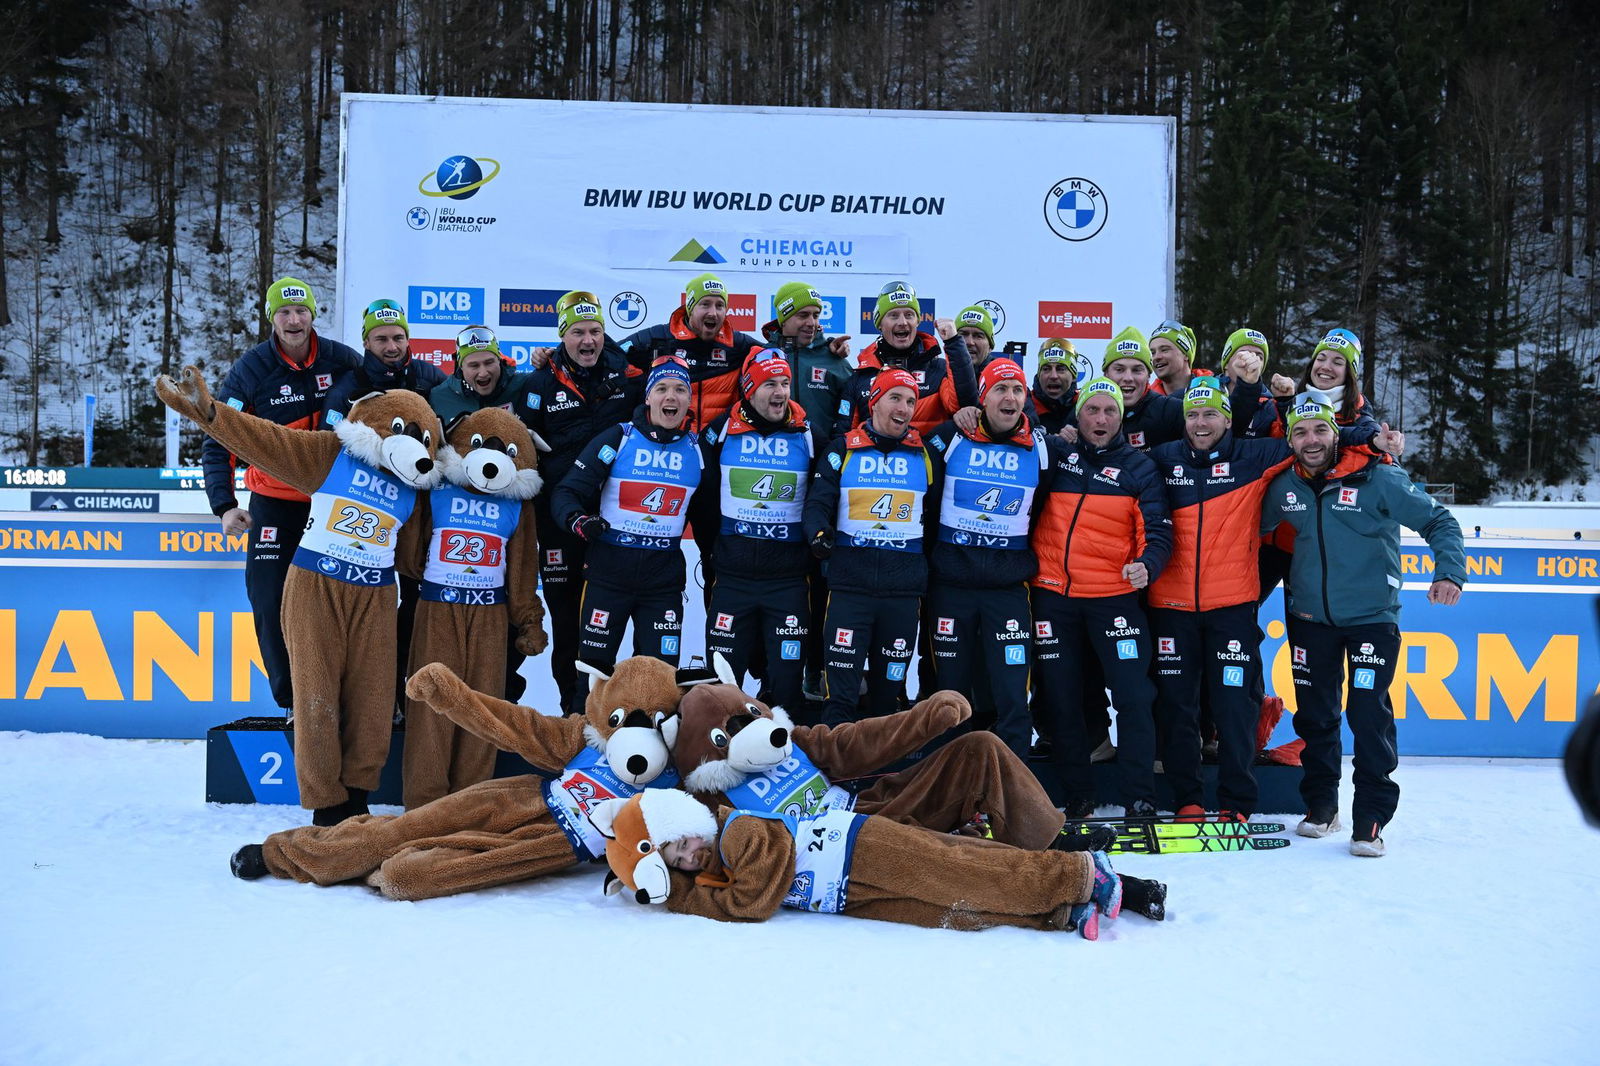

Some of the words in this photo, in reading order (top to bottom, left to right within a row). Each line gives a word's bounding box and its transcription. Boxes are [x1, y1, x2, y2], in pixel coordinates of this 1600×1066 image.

[1053, 181, 1099, 198] BMW
[584, 188, 642, 208] BMW
[647, 190, 686, 208] IBU
[691, 192, 772, 211] WORLD
[778, 193, 826, 212] CUP
[830, 195, 945, 215] BIATHLON
[440, 208, 456, 216] IBU
[438, 216, 476, 224] WORLD
[476, 217, 497, 225] CUP
[437, 224, 482, 232] BIATHLON
[740, 238, 854, 256] CHIEMGAU
[740, 258, 854, 268] RUHPOLDING
[283, 288, 304, 298] claro
[890, 292, 910, 300] claro
[421, 291, 472, 312] DKB
[501, 302, 558, 313] HÖRMA
[376, 309, 398, 318] claro
[576, 304, 596, 314] claro
[962, 312, 982, 321] claro
[1041, 312, 1110, 328] VIESSMANN
[1118, 342, 1138, 351] claro
[1324, 336, 1346, 346] claro
[1044, 348, 1064, 358] claro
[1090, 383, 1116, 393] claro
[1188, 390, 1210, 398] claro
[270, 394, 304, 406] tectake
[547, 400, 580, 413] tectake
[1297, 404, 1320, 414] claro
[741, 436, 789, 457] DKB
[634, 449, 682, 470] DKB
[772, 458, 789, 466] Bank
[859, 456, 908, 475] DKB
[969, 448, 1019, 471] DKB
[1058, 460, 1084, 476] tectake
[4, 470, 66, 486] 16:08:08
[665, 472, 680, 480] Bank
[966, 468, 981, 476] Das
[983, 470, 998, 478] kann
[1000, 472, 1016, 481] Bank
[1093, 474, 1120, 487] Kaufland
[352, 469, 398, 500] DKB
[751, 474, 775, 498] 4
[778, 485, 794, 499] 2
[1166, 477, 1194, 486] tectake
[1206, 477, 1235, 485] Kaufland
[74, 496, 152, 510] CHIEMGAU
[349, 487, 361, 497] Das
[362, 492, 378, 504] kann
[380, 498, 395, 509] Bank
[641, 487, 664, 512] 4
[976, 488, 1002, 511] 4
[1005, 499, 1021, 514] 4
[451, 497, 500, 519] DKB
[738, 508, 786, 517] CHIEMGAU
[870, 494, 893, 518] 4
[897, 504, 911, 520] 3
[1281, 502, 1307, 512] tectake
[1332, 504, 1362, 512] Kaufland
[334, 506, 380, 539] 23
[464, 517, 480, 525] kann
[482, 519, 498, 528] Bank
[624, 520, 672, 532] CHIEMGAU
[958, 518, 1009, 531] CHIEMGAU
[757, 524, 789, 539] iX3
[856, 530, 904, 538] CHIEMGAU
[255, 542, 280, 550] Kaufland
[446, 534, 486, 562] 23
[326, 550, 381, 567] RUHPOLDING
[328, 543, 381, 562] CHIEMGAU
[1538, 556, 1598, 578] HÖR
[346, 566, 381, 584] iX3
[446, 573, 494, 583] CHIEMGAU
[466, 591, 495, 605] iX3
[585, 624, 610, 636] Kaufland
[654, 621, 682, 630] tectak
[776, 626, 808, 636] tectake
[710, 629, 736, 638] Kaufland
[996, 631, 1030, 641] tectake
[1106, 626, 1140, 638] tectake
[586, 640, 608, 648] TERREX
[714, 646, 734, 654] TERREX
[829, 644, 856, 654] Kaufland
[1120, 642, 1134, 657] TQ
[1008, 648, 1022, 662] TQ
[1040, 652, 1060, 660] TERREX
[1216, 651, 1250, 662] tectake
[1352, 653, 1386, 666] tectake
[833, 661, 854, 669] TERREX
[1160, 668, 1182, 676] TERREX
[1226, 668, 1240, 684] TQ
[260, 752, 283, 784] 2
[747, 759, 800, 798] DKB
[764, 794, 778, 806] Das
[777, 779, 794, 793] kann
[792, 768, 808, 780] Bank
[808, 828, 827, 852] 24
